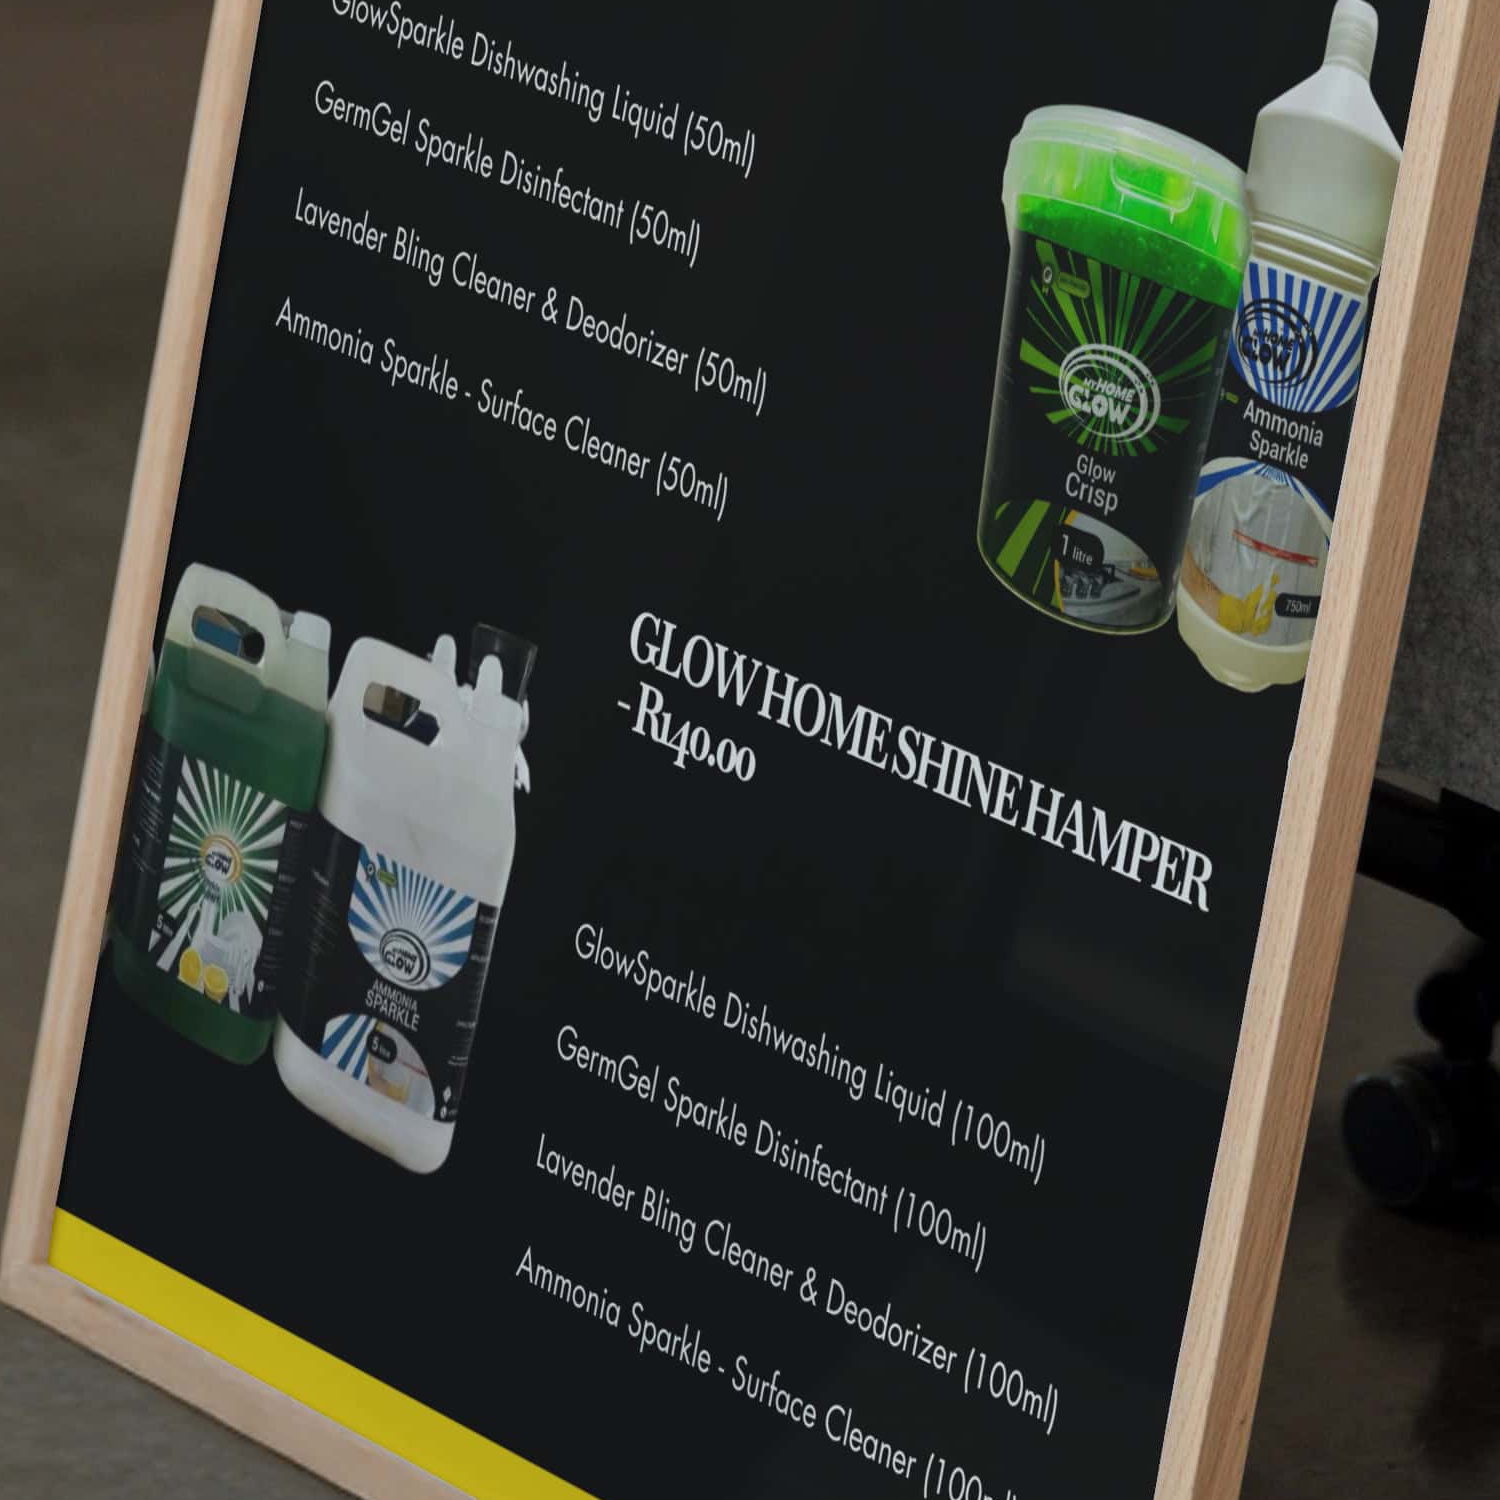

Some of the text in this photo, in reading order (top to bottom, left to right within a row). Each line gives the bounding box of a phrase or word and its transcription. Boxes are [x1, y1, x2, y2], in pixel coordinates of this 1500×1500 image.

[471, 32, 604, 122] Dishwashing
[612, 84, 679, 140] Liquid
[684, 111, 755, 179] (50ml)
[315, 80, 700, 268] GermGel Sparkle Disinfectant (50ml)
[295, 187, 766, 416] Lavender Bling Cleaner & Deodorizer (50ml)
[276, 296, 373, 364] Ammonia
[381, 338, 458, 399] Sparkle
[478, 379, 556, 440] Surface
[565, 416, 650, 479] Cleaner
[657, 452, 727, 522] (50ml)
[1069, 384, 1131, 425] GLOW
[1095, 378, 1135, 403] HOME
[1243, 398, 1324, 448] Ammonia
[1076, 454, 1116, 484] Glow
[1249, 429, 1309, 470] Sparkle
[1065, 472, 1119, 516] Crisp
[1062, 534, 1093, 566] 1 litre
[1285, 599, 1311, 615] 750ml
[630, 612, 1212, 912] GLOW HOME SHINE HAMPER
[365, 990, 420, 1032] SPARKLE
[372, 977, 418, 1012] AMMONIA
[575, 924, 716, 1018] GlowSparkle
[724, 992, 866, 1100] Dishwashing
[875, 1064, 946, 1128] Liquid
[952, 1100, 1044, 1185] (100ml)
[558, 1025, 986, 1272] GermGel Sparkle Disinfectant (100ml)
[537, 1133, 1058, 1435] Lavender Bling Cleaner & Deodorizer (100ml)
[516, 1246, 620, 1327] Ammonia
[628, 1302, 711, 1373] Sparkle
[732, 1355, 816, 1428] Surface
[825, 1404, 916, 1478] Cleaner
